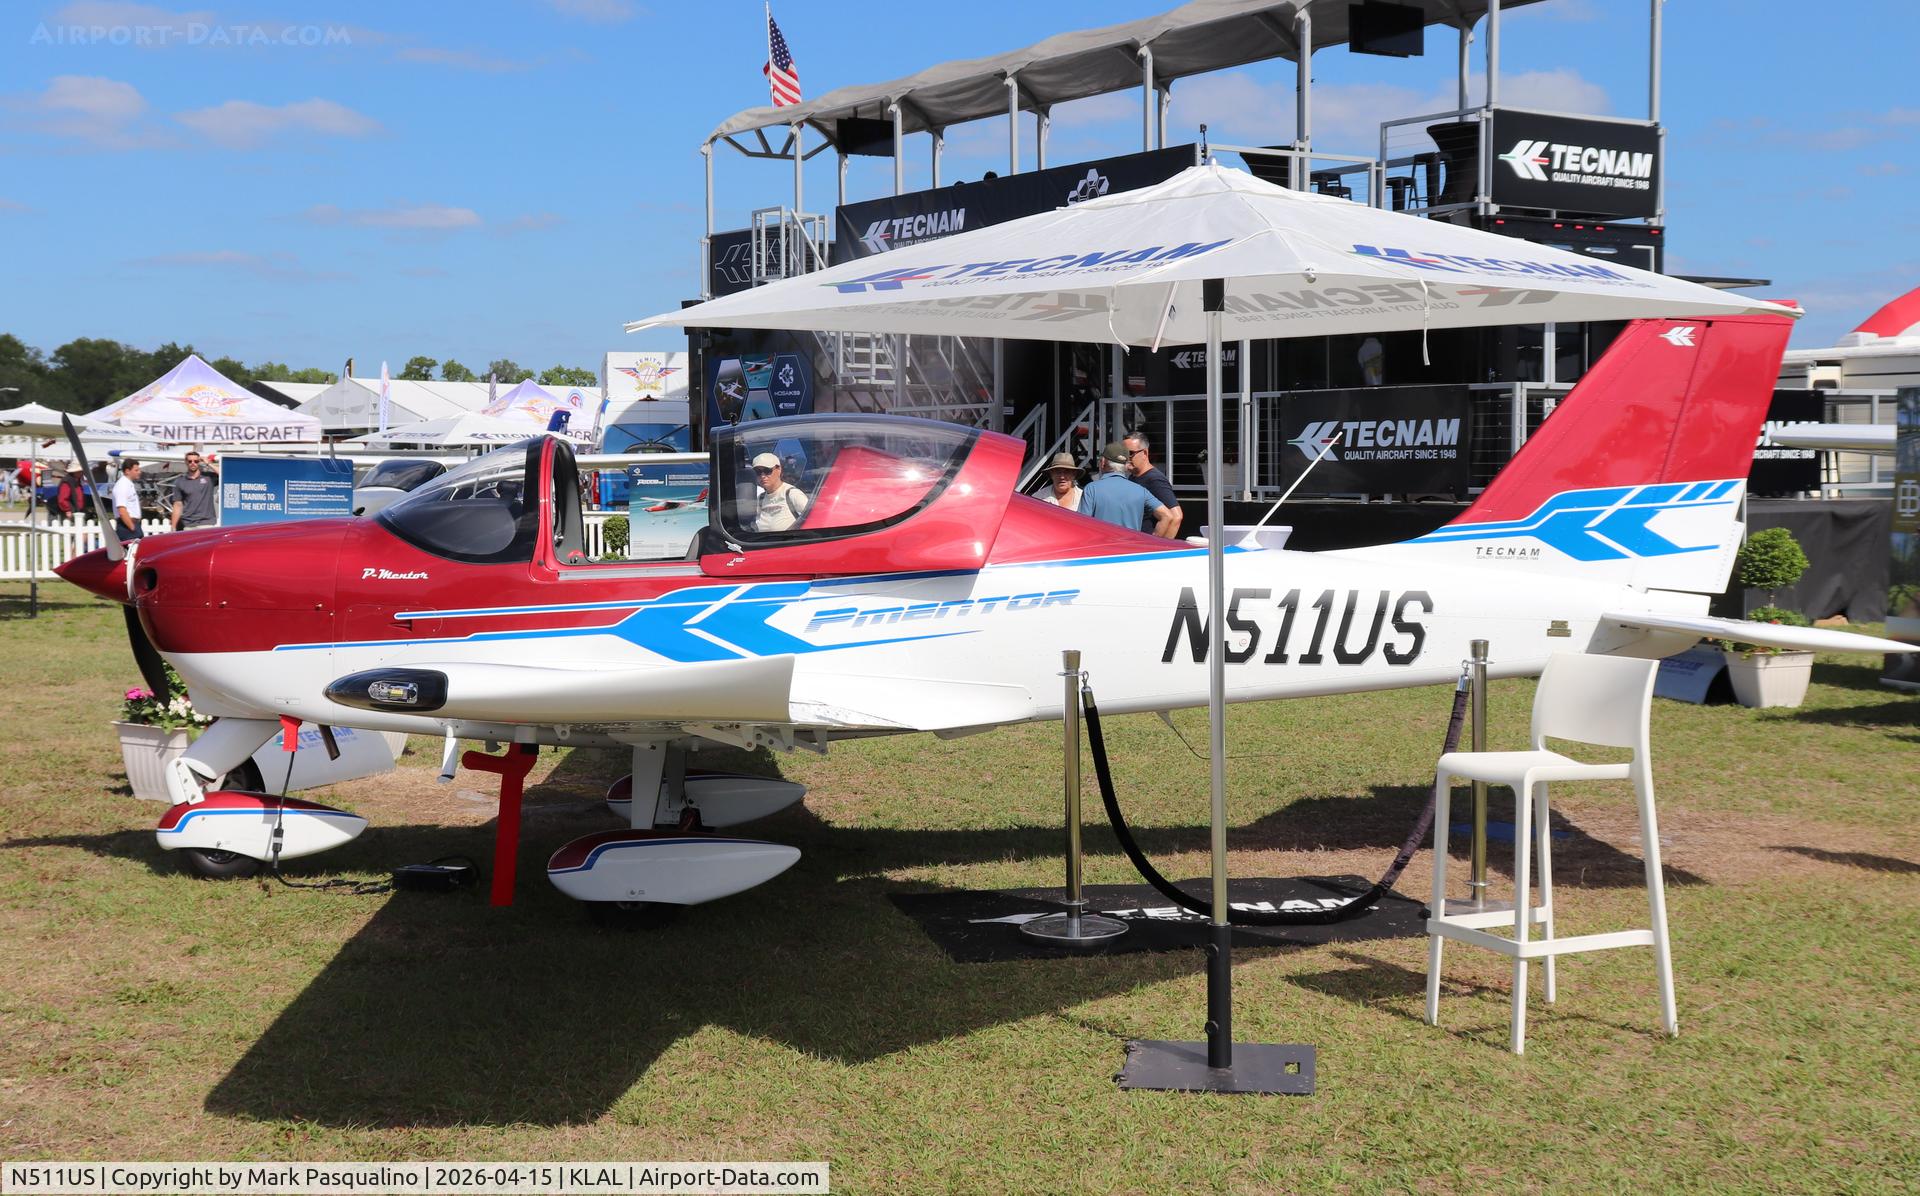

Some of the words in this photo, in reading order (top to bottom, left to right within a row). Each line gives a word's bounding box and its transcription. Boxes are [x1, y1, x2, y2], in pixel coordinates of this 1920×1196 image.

[1550, 144, 1653, 178] TECNAM
[1552, 172, 1581, 184] QUALITY
[1581, 175, 1613, 187] AIRCRAFT
[1614, 178, 1634, 189] SINCE
[1635, 180, 1650, 190] 1948
[892, 208, 966, 240] TECNAM
[942, 238, 1234, 279] TECNAM
[1418, 252, 1633, 281] TECNAM
[922, 277, 990, 288] QUALITY
[994, 268, 1081, 282] AIRCRAFT
[634, 357, 662, 367] ZENITH
[139, 424, 206, 441] ZENITH
[212, 425, 305, 441] AIRCRAFT
[1342, 418, 1460, 448] TECNAM
[1344, 450, 1375, 461] QUALITY
[1376, 450, 1413, 460] AIRCRAFT
[1414, 449, 1437, 459] SINCE
[1439, 449, 1457, 459] 1948
[241, 483, 267, 491] BRINGING
[240, 493, 266, 501] TRAINING
[267, 493, 275, 501] TO
[241, 502, 251, 511] THE
[252, 502, 266, 511] NEXT
[267, 503, 282, 511] LEVEL
[1476, 547, 1540, 556] TECNAM
[362, 568, 429, 579] P-Mentor
[1161, 586, 1434, 665] N511US
[299, 726, 354, 743] TECAM
